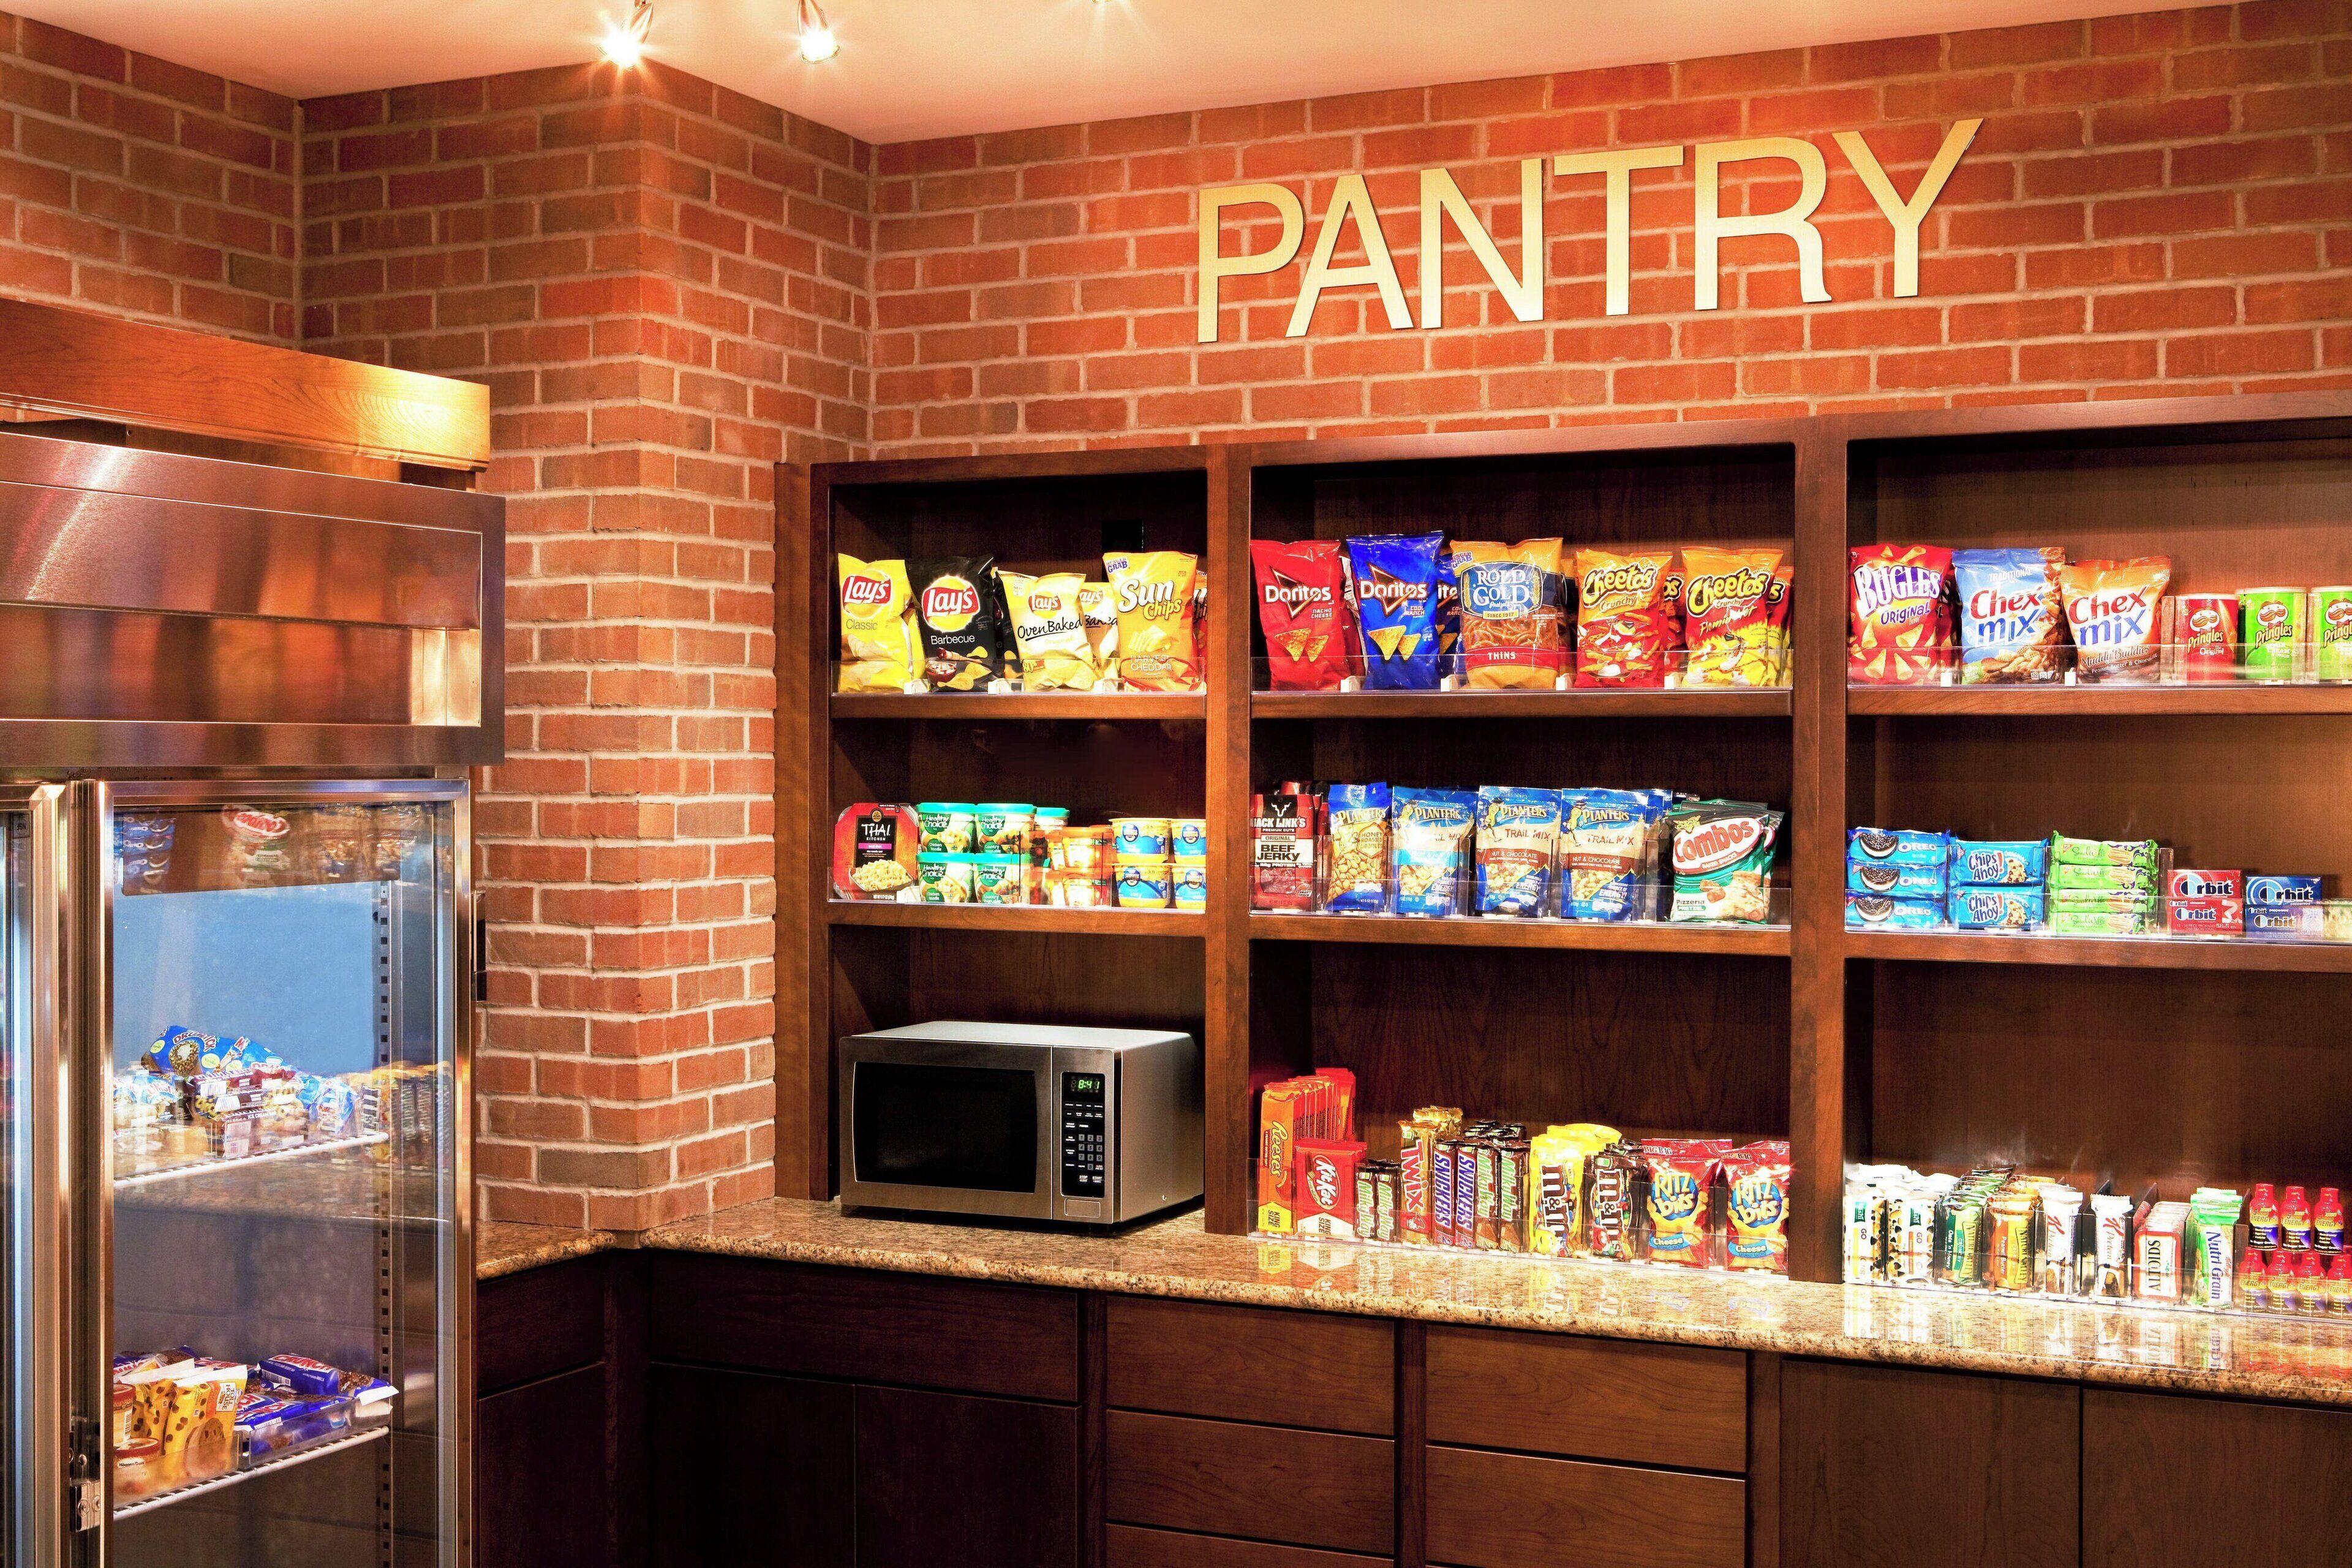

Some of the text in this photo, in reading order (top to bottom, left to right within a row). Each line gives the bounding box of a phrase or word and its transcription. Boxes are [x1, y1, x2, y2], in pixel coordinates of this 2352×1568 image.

[1197, 118, 1985, 343] PANTRY
[1107, 560, 1128, 573] GRAB
[1989, 568, 2033, 582] TRADITIONAL
[1476, 570, 1526, 586] ROLD
[1582, 564, 1656, 608] Cheetos
[843, 576, 890, 604] Lay's
[1117, 578, 1175, 613] Sun
[1265, 584, 1332, 604] Doritos
[1360, 581, 1428, 600] Doritos
[1472, 584, 1529, 606] GOLD
[1687, 568, 1768, 613] Cheetos
[1853, 564, 1942, 619] BUGLES
[926, 586, 975, 617] Lay's
[1143, 598, 1183, 621] Chips
[1599, 595, 1638, 612] Crunchy
[1716, 598, 1744, 609] Crunchy
[1970, 585, 2044, 620] Chex
[2068, 586, 2148, 625] Chex
[846, 619, 878, 630] Classic
[1017, 624, 1046, 640] Oven
[1048, 616, 1083, 633] Baked
[1977, 609, 2040, 646] mix
[2079, 608, 2147, 646] mix
[930, 633, 975, 645] Barbecue
[2188, 628, 2224, 654] Pringles
[2255, 622, 2293, 649] Pringles
[1487, 651, 1517, 661] THINS
[2082, 645, 2151, 668] Muddy Buddies
[1131, 663, 1172, 672] CHEDDAR
[1338, 808, 1387, 826] PLANTERS
[1415, 807, 1461, 821] PLANTERS
[1501, 805, 1547, 820] PLANTERS
[1583, 809, 1630, 824] PLANTERS
[861, 823, 891, 837] THAI
[924, 821, 948, 829] Choice
[1276, 817, 1306, 829] LINK'S
[1505, 828, 1551, 842] TRAIL MIX
[1587, 834, 1615, 844] TRAIL
[1674, 821, 1755, 863] Combos
[1261, 844, 1295, 853] BEEF
[1898, 842, 1937, 853] OREO
[1257, 853, 1301, 862] JERKY
[1968, 851, 1997, 869] Chips
[1899, 876, 1937, 887] OREO
[2180, 880, 2233, 897] Orbit
[1968, 893, 1997, 911] Chips
[2259, 886, 2315, 903] Orbit
[1893, 906, 1931, 917] OREO
[2175, 907, 2217, 921] Orbit
[2254, 914, 2296, 929] Orbit
[1078, 1080, 1100, 1090] 8:41
[1270, 1120, 1289, 1178] Reese's
[1643, 1145, 1658, 1154] BIG
[1401, 1140, 1428, 1212] Twix
[1477, 1153, 1493, 1194] Milky
[1434, 1153, 1452, 1229] SNICKERS
[1456, 1154, 1475, 1230] SNICKERS
[1501, 1157, 1518, 1222] Milky Way
[1655, 1172, 1692, 1198] RITZ
[1736, 1178, 1774, 1205] RITZ
[1357, 1180, 1375, 1237] Milky Way
[1377, 1182, 1394, 1240] Milky Way
[1654, 1193, 1695, 1217] bits
[1736, 1200, 1779, 1224] bits
[2103, 1216, 2125, 1237] K
[1654, 1236, 1684, 1246] Cheese
[1735, 1245, 1768, 1254] Cheese
[2019, 1229, 2028, 1281] NATURE VALLEY
[2147, 1239, 2162, 1292] ALTOIDS
[2206, 1231, 2225, 1300] Nutri Grain
[273, 1355, 334, 1373] CRUNCH
